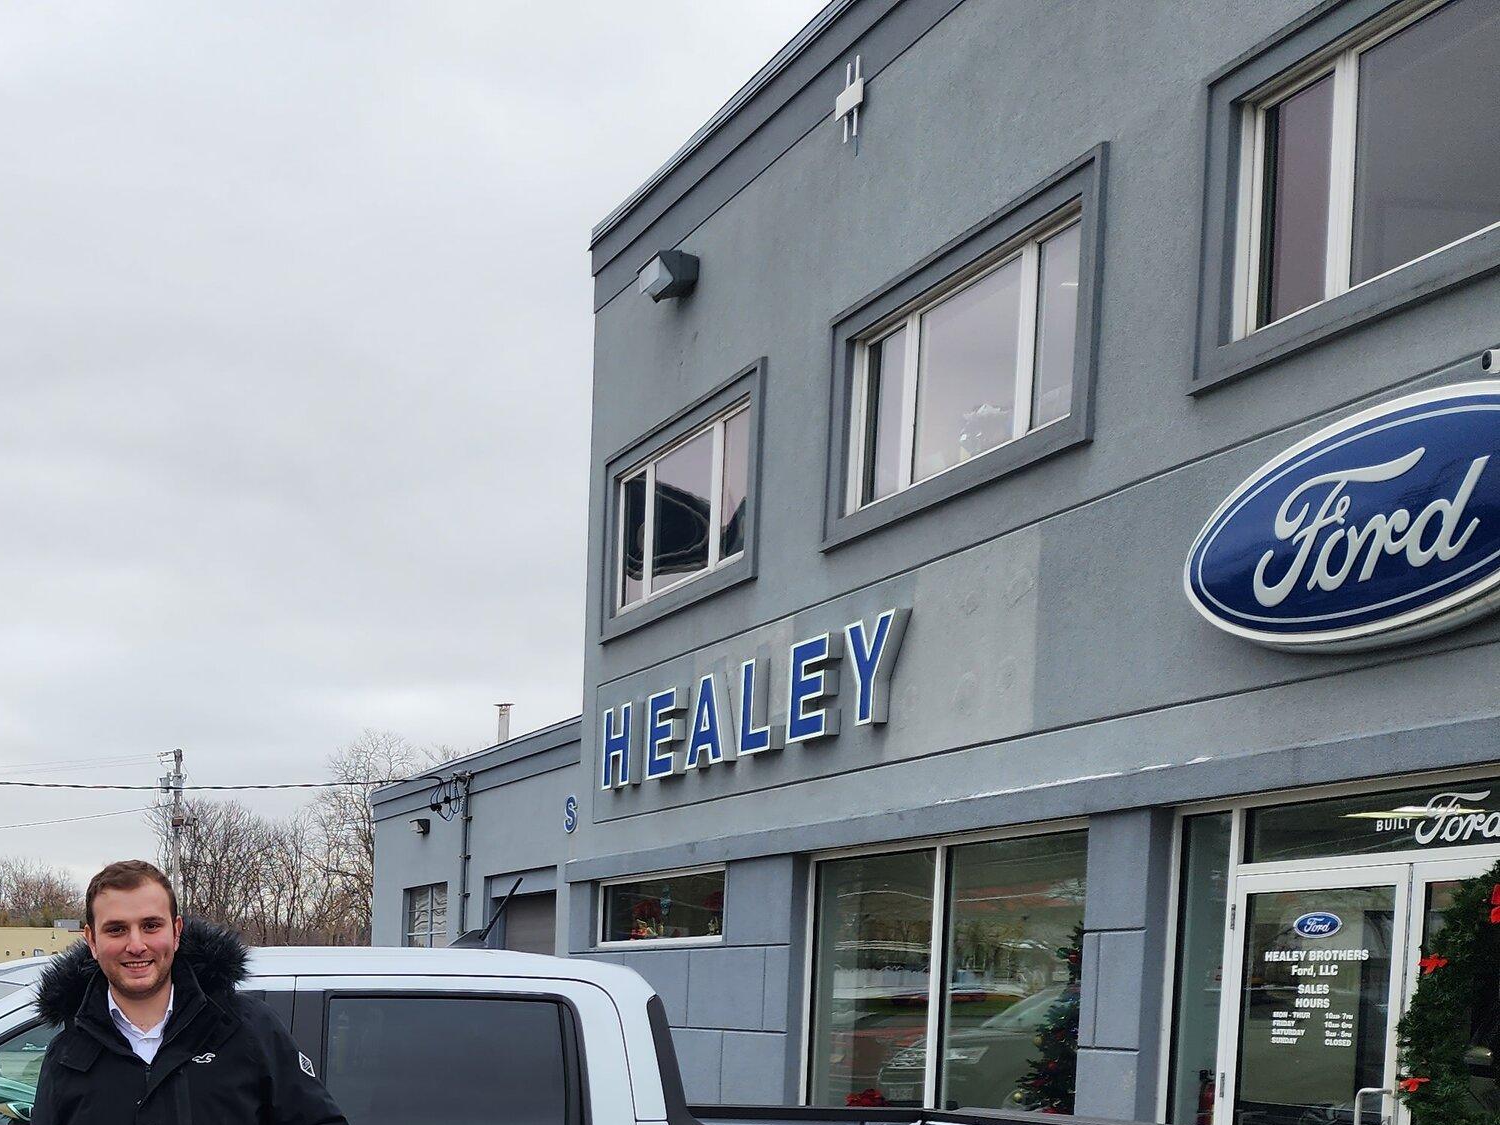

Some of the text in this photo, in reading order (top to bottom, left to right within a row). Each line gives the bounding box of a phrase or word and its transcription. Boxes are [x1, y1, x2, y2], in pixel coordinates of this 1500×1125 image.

[1253, 447, 1491, 608] Ford
[601, 608, 902, 790] HEALEY
[1376, 817, 1411, 832] BUILT
[1303, 917, 1331, 933] Ford
[1264, 949, 1370, 962] HEALEY BROTHERS
[1291, 964, 1338, 978] Ford, LLC
[1297, 983, 1330, 995] SALES
[1295, 998, 1330, 1009] HOURS
[1272, 1011, 1289, 1019] MON
[1293, 1011, 1311, 1019] THUR
[1272, 1019, 1296, 1027] FRIDAY
[1271, 1028, 1306, 1037] SATURDAY
[1271, 1036, 1298, 1045] SUNDAY
[1324, 1038, 1352, 1047] CLOSED
